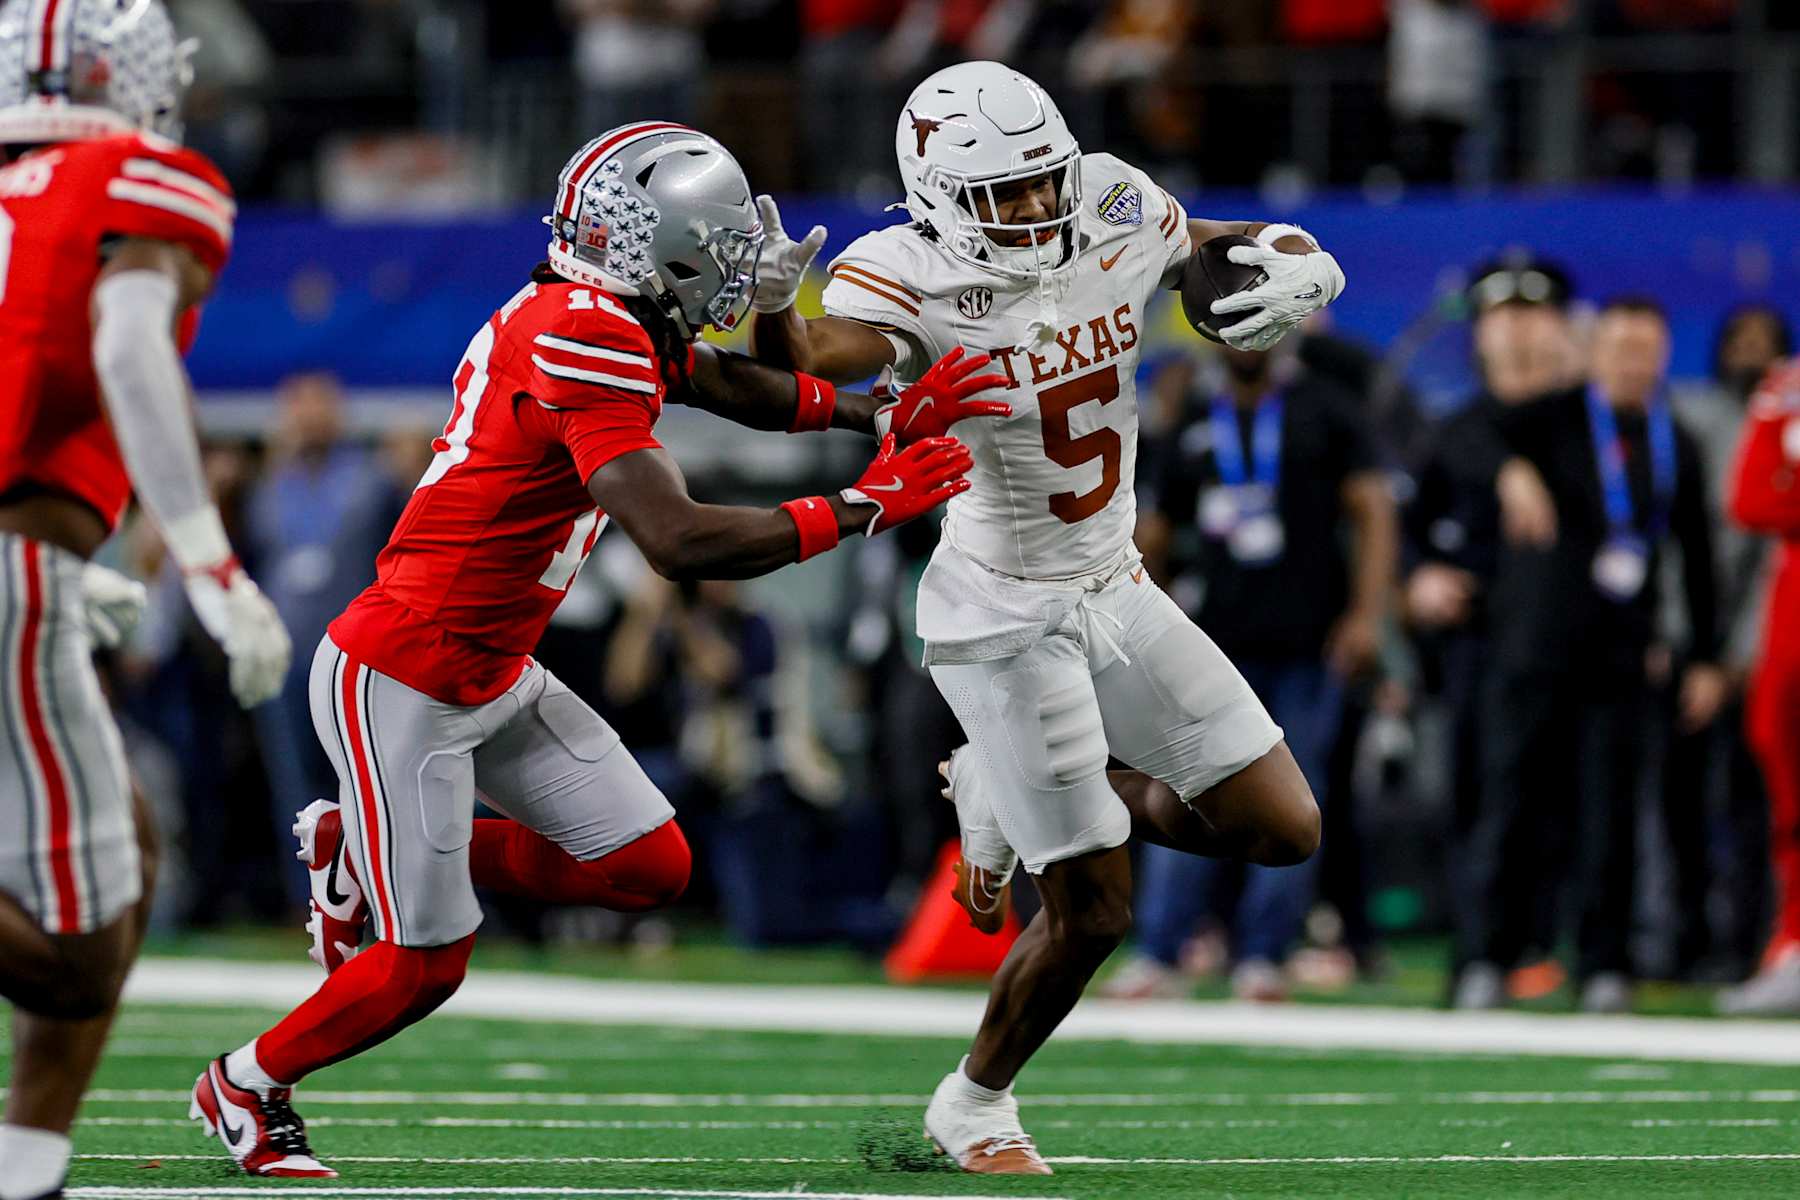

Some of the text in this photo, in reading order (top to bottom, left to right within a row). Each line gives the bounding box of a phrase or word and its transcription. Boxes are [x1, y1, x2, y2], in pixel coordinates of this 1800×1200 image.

[959, 287, 991, 318] SEC
[989, 303, 1138, 391] TEXAS
[1036, 364, 1122, 525] 5
